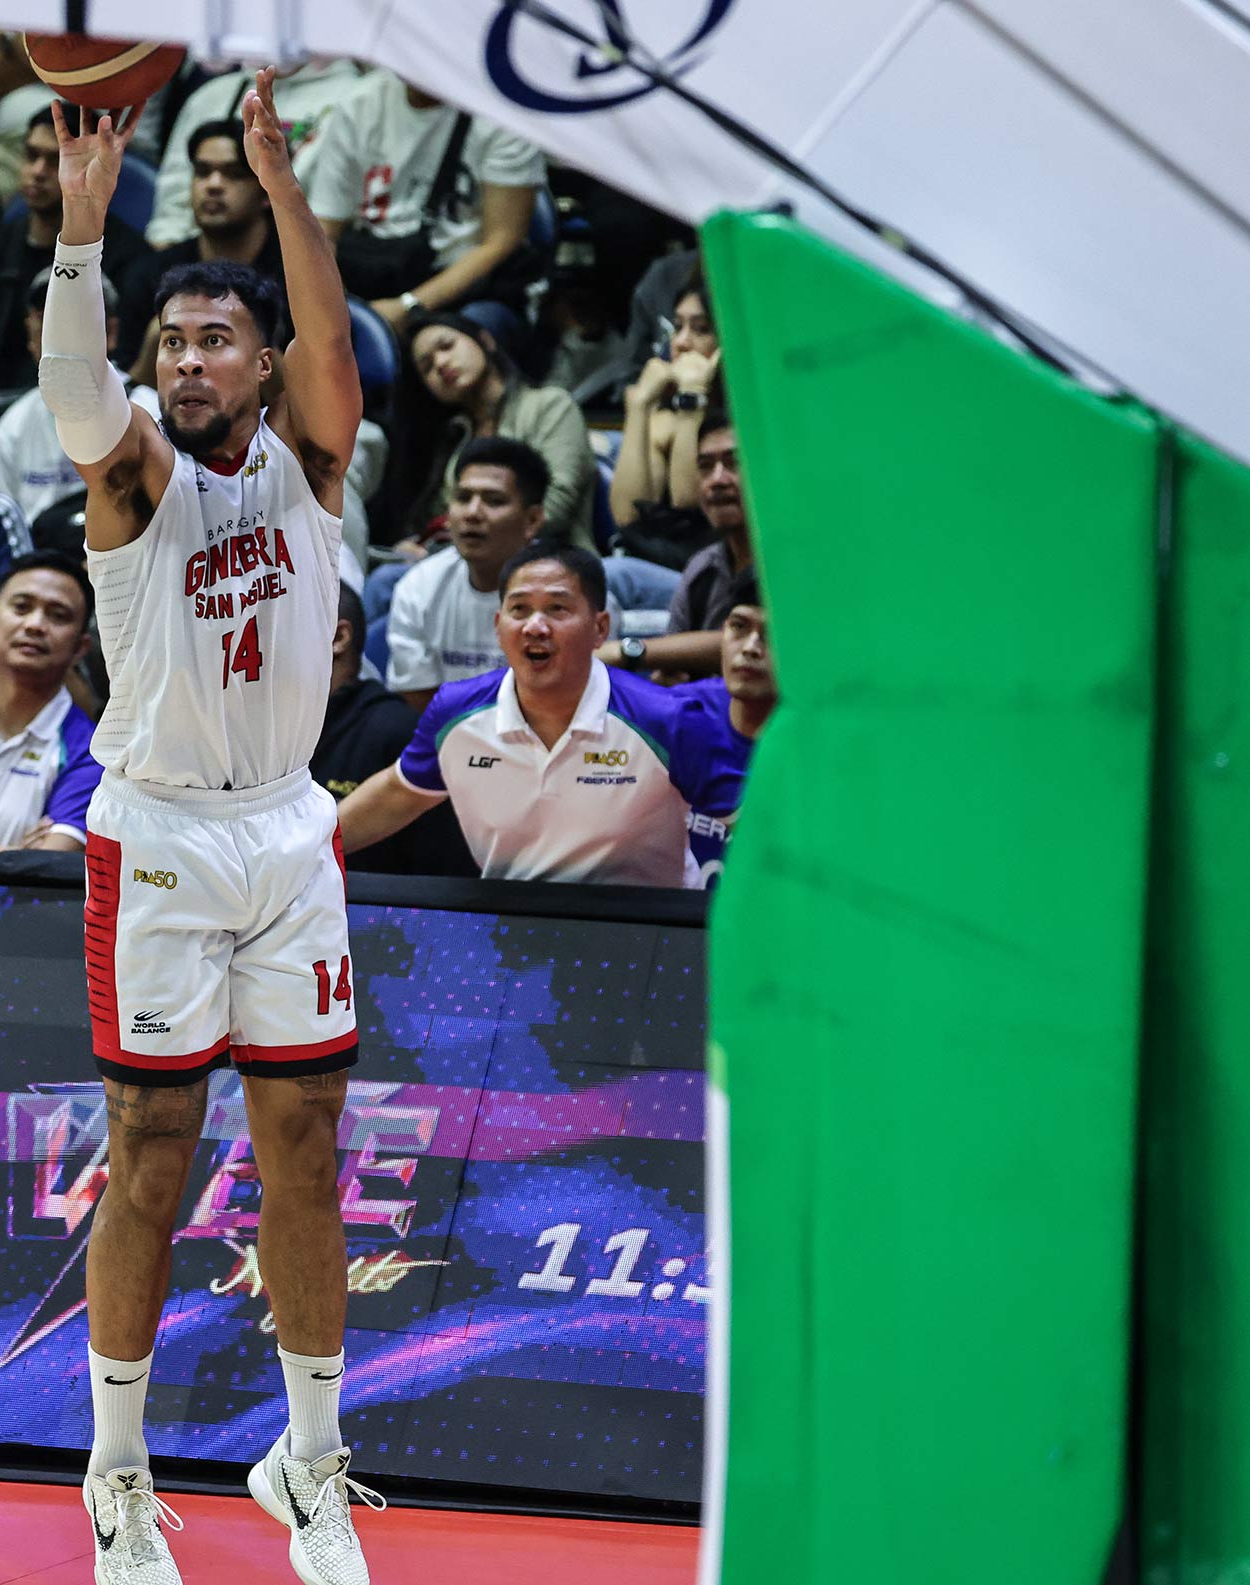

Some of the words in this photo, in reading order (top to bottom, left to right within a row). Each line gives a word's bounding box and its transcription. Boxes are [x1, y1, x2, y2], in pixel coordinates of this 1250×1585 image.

[195, 592, 234, 619] SAN
[222, 615, 263, 690] 14
[312, 955, 351, 1015] 14
[517, 1222, 715, 1304] 11:
